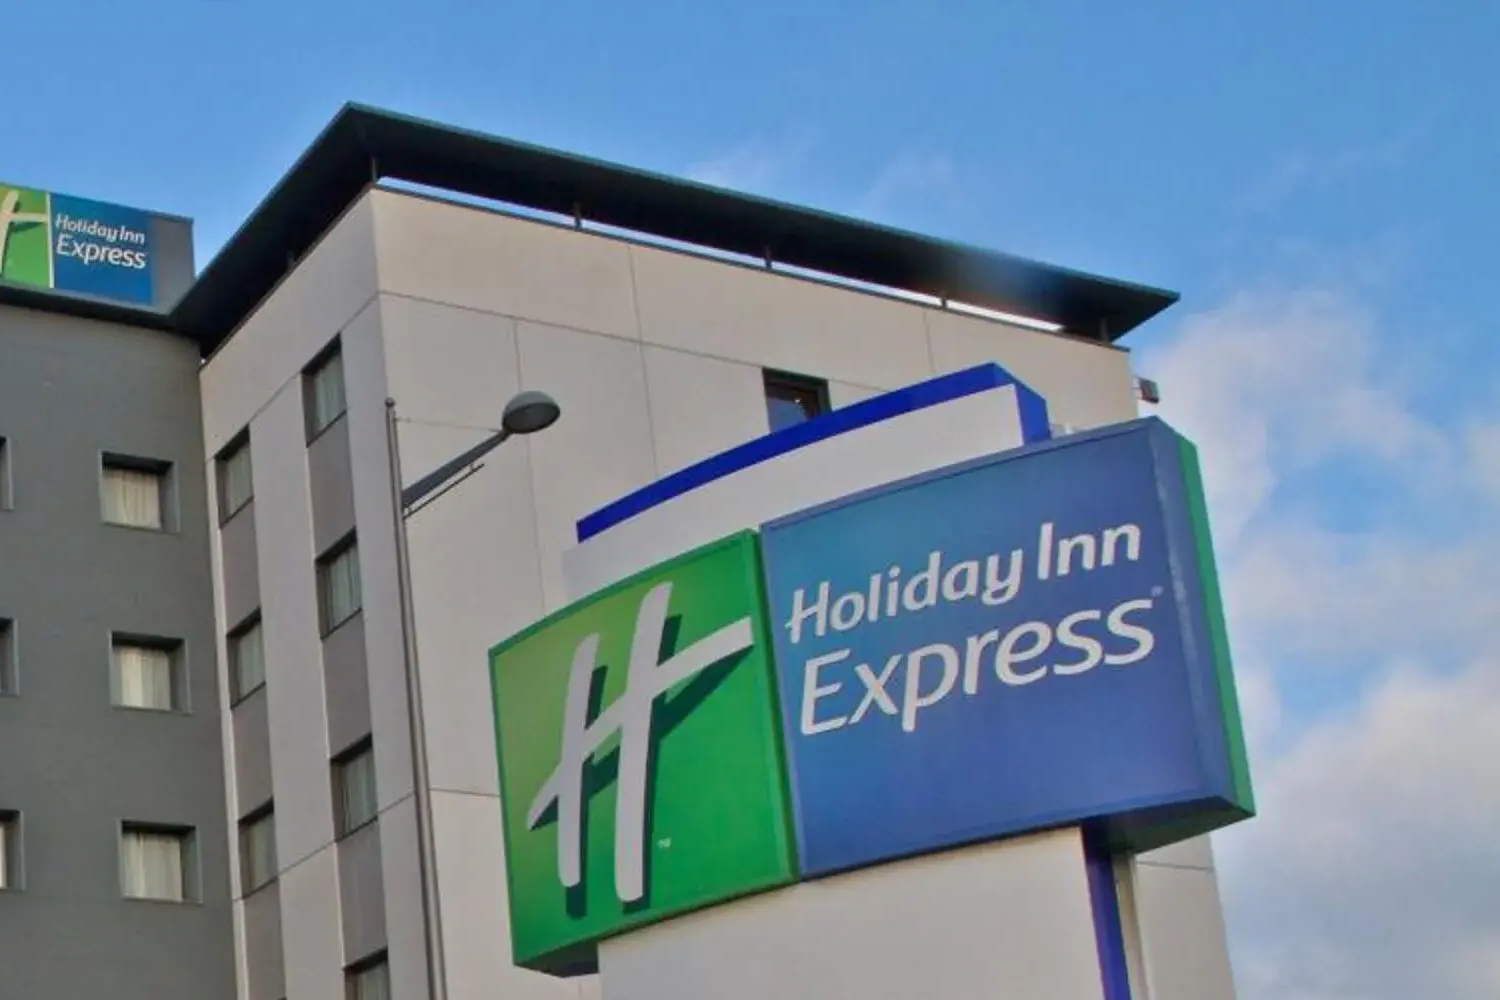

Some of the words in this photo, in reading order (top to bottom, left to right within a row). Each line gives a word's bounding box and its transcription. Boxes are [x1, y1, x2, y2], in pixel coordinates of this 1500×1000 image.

[55, 213, 117, 242] Holiday
[120, 225, 145, 245] Inn
[57, 233, 146, 269] Express
[785, 549, 1022, 643] Holiday
[1037, 522, 1140, 580] Inn
[801, 599, 1155, 735] Express
